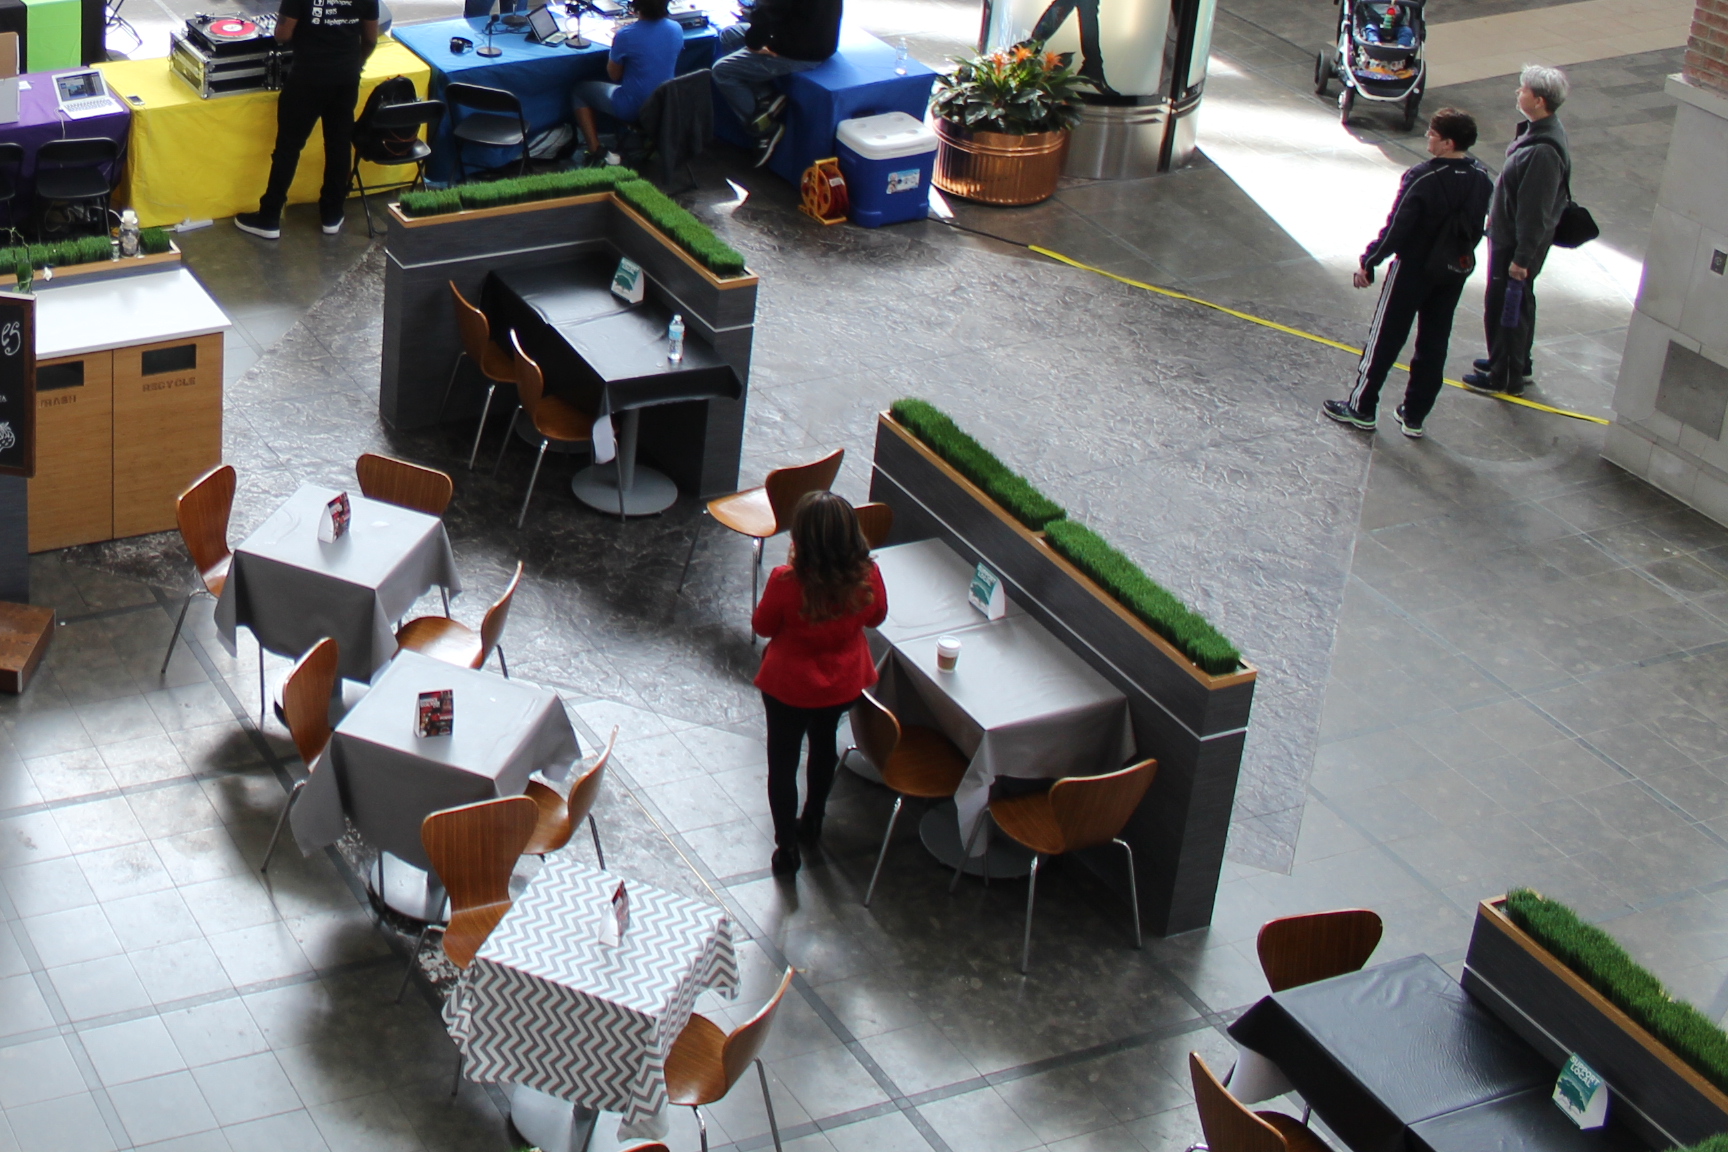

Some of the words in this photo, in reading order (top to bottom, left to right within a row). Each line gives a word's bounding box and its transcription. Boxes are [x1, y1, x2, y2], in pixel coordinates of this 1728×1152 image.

[142, 377, 196, 393] RECYCLE
[1570, 1055, 1601, 1086] SUPPORT
[1570, 1064, 1591, 1088] LOCAL
